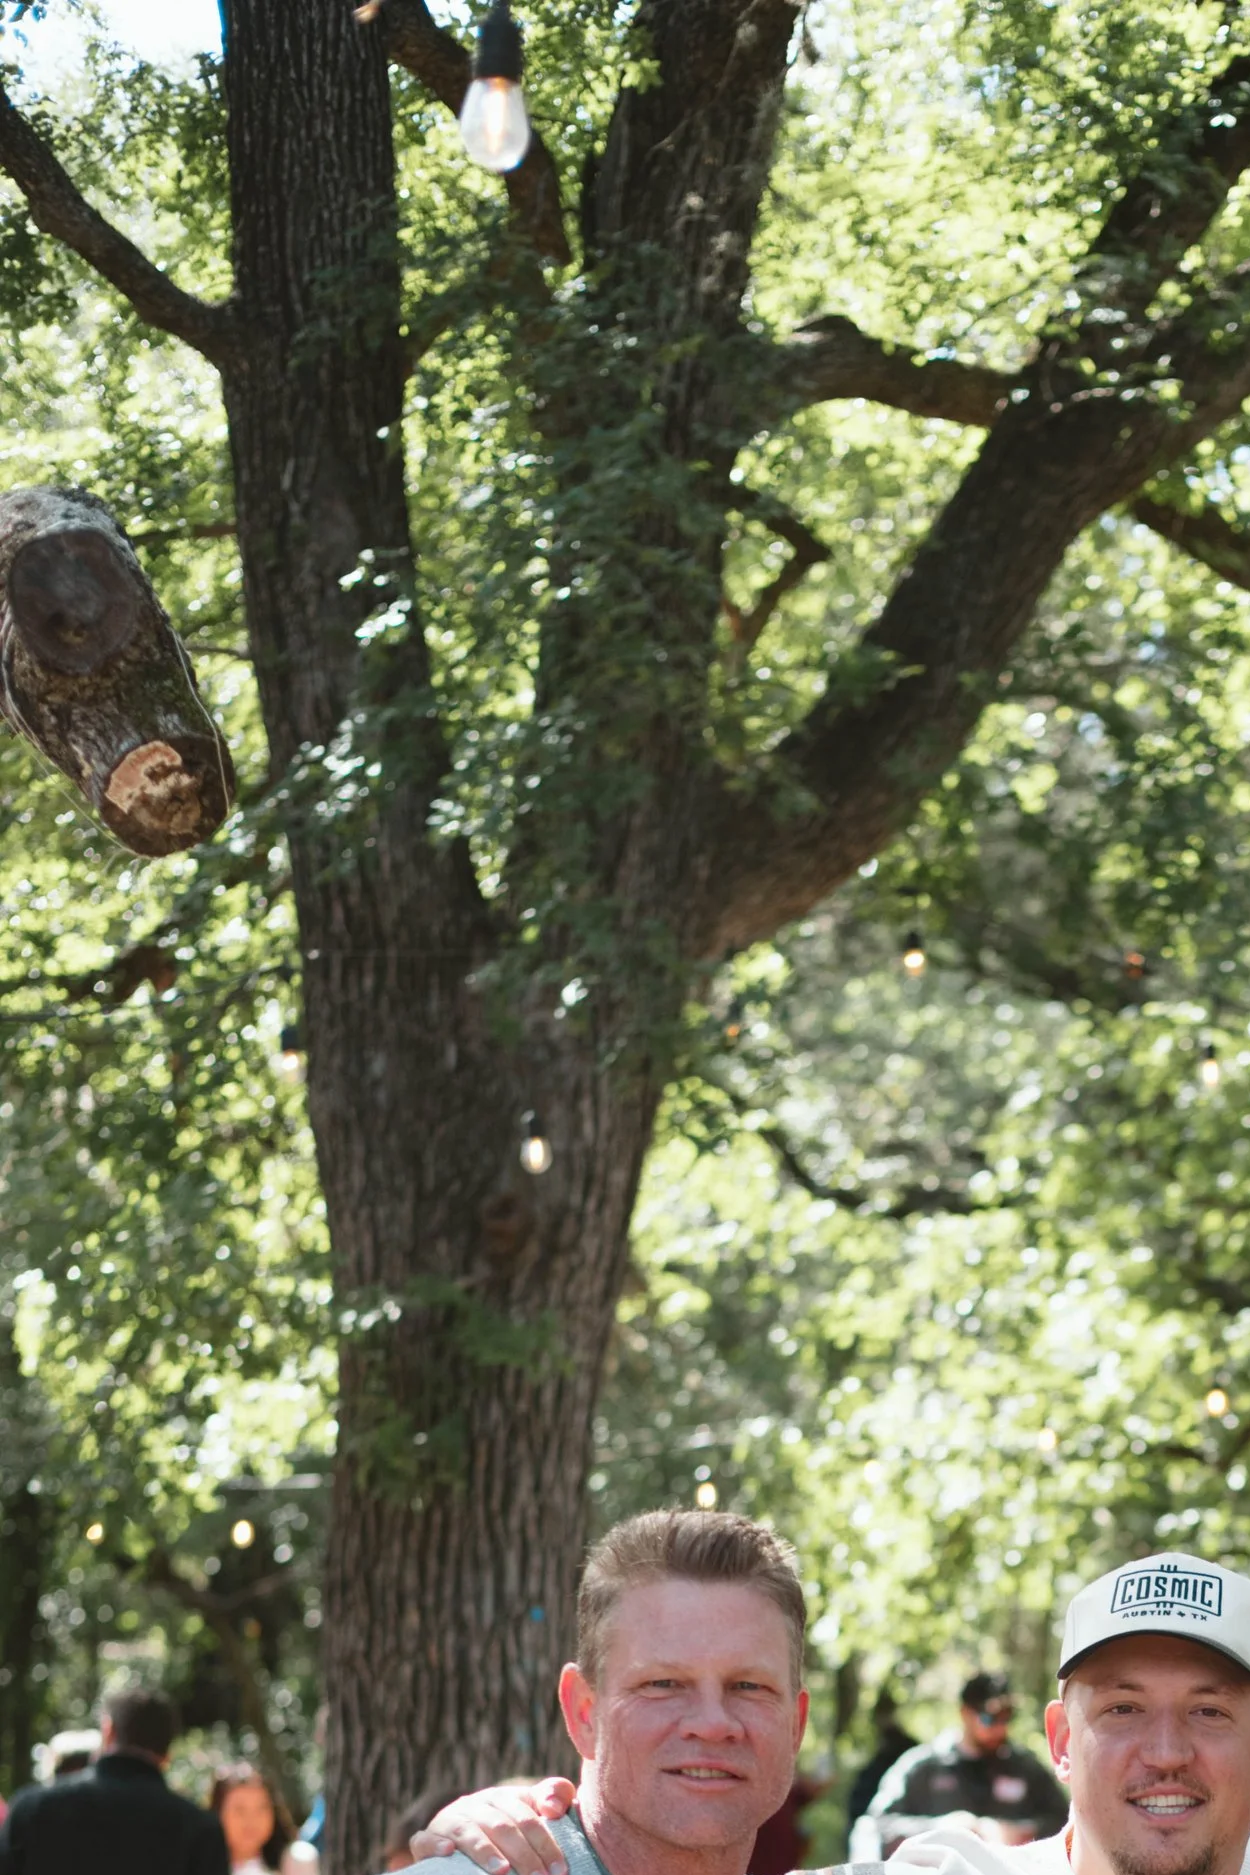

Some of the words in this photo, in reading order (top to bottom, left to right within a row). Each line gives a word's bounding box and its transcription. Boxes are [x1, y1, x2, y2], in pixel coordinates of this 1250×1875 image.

[1120, 1576, 1213, 1608] COSMIC
[1122, 1610, 1171, 1619] AUSTIN
[1191, 1613, 1208, 1622] TX
